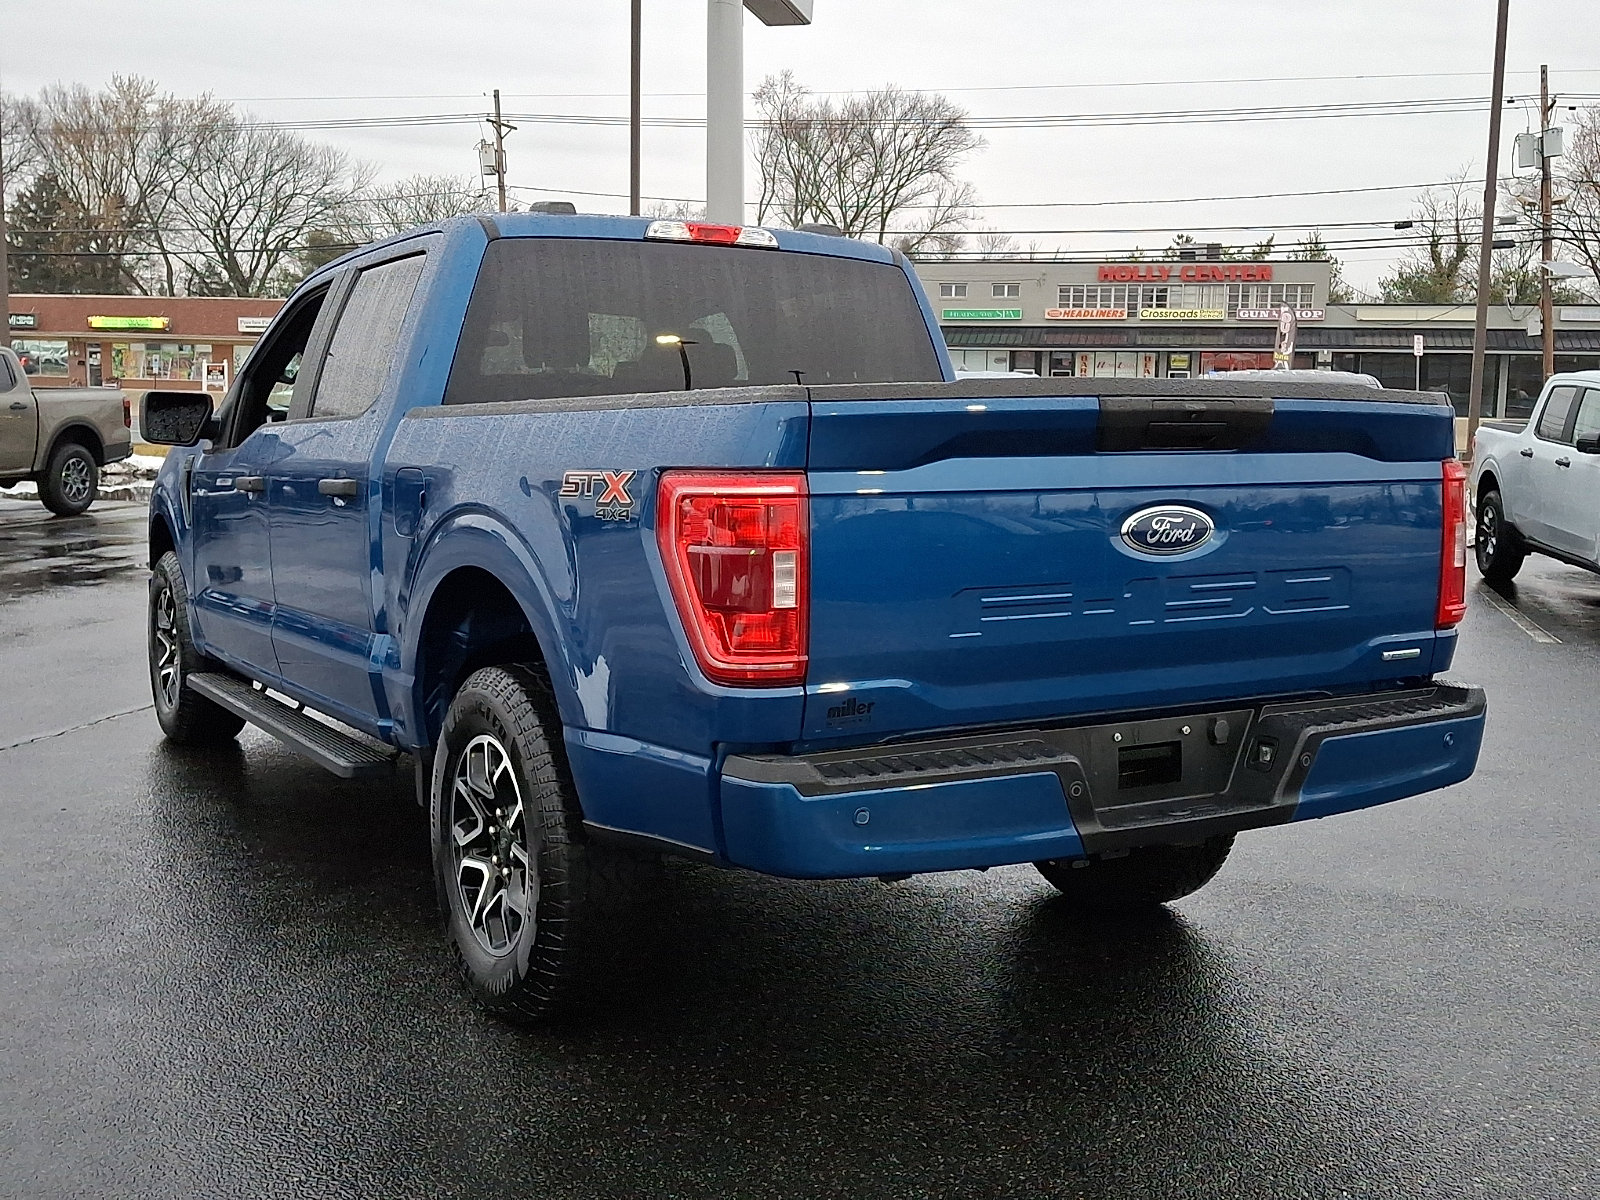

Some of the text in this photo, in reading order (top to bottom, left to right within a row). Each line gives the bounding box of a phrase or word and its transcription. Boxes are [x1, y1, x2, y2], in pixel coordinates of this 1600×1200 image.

[1097, 265, 1273, 282] HOLLY CENTER
[995, 309, 1015, 318] SPA
[1062, 309, 1126, 318] HEADLINERS
[1140, 309, 1198, 318] Crossroads
[1239, 310, 1270, 318] GUN
[558, 469, 637, 508] STX
[1146, 516, 1196, 544] Ford
[827, 697, 876, 719] miller
